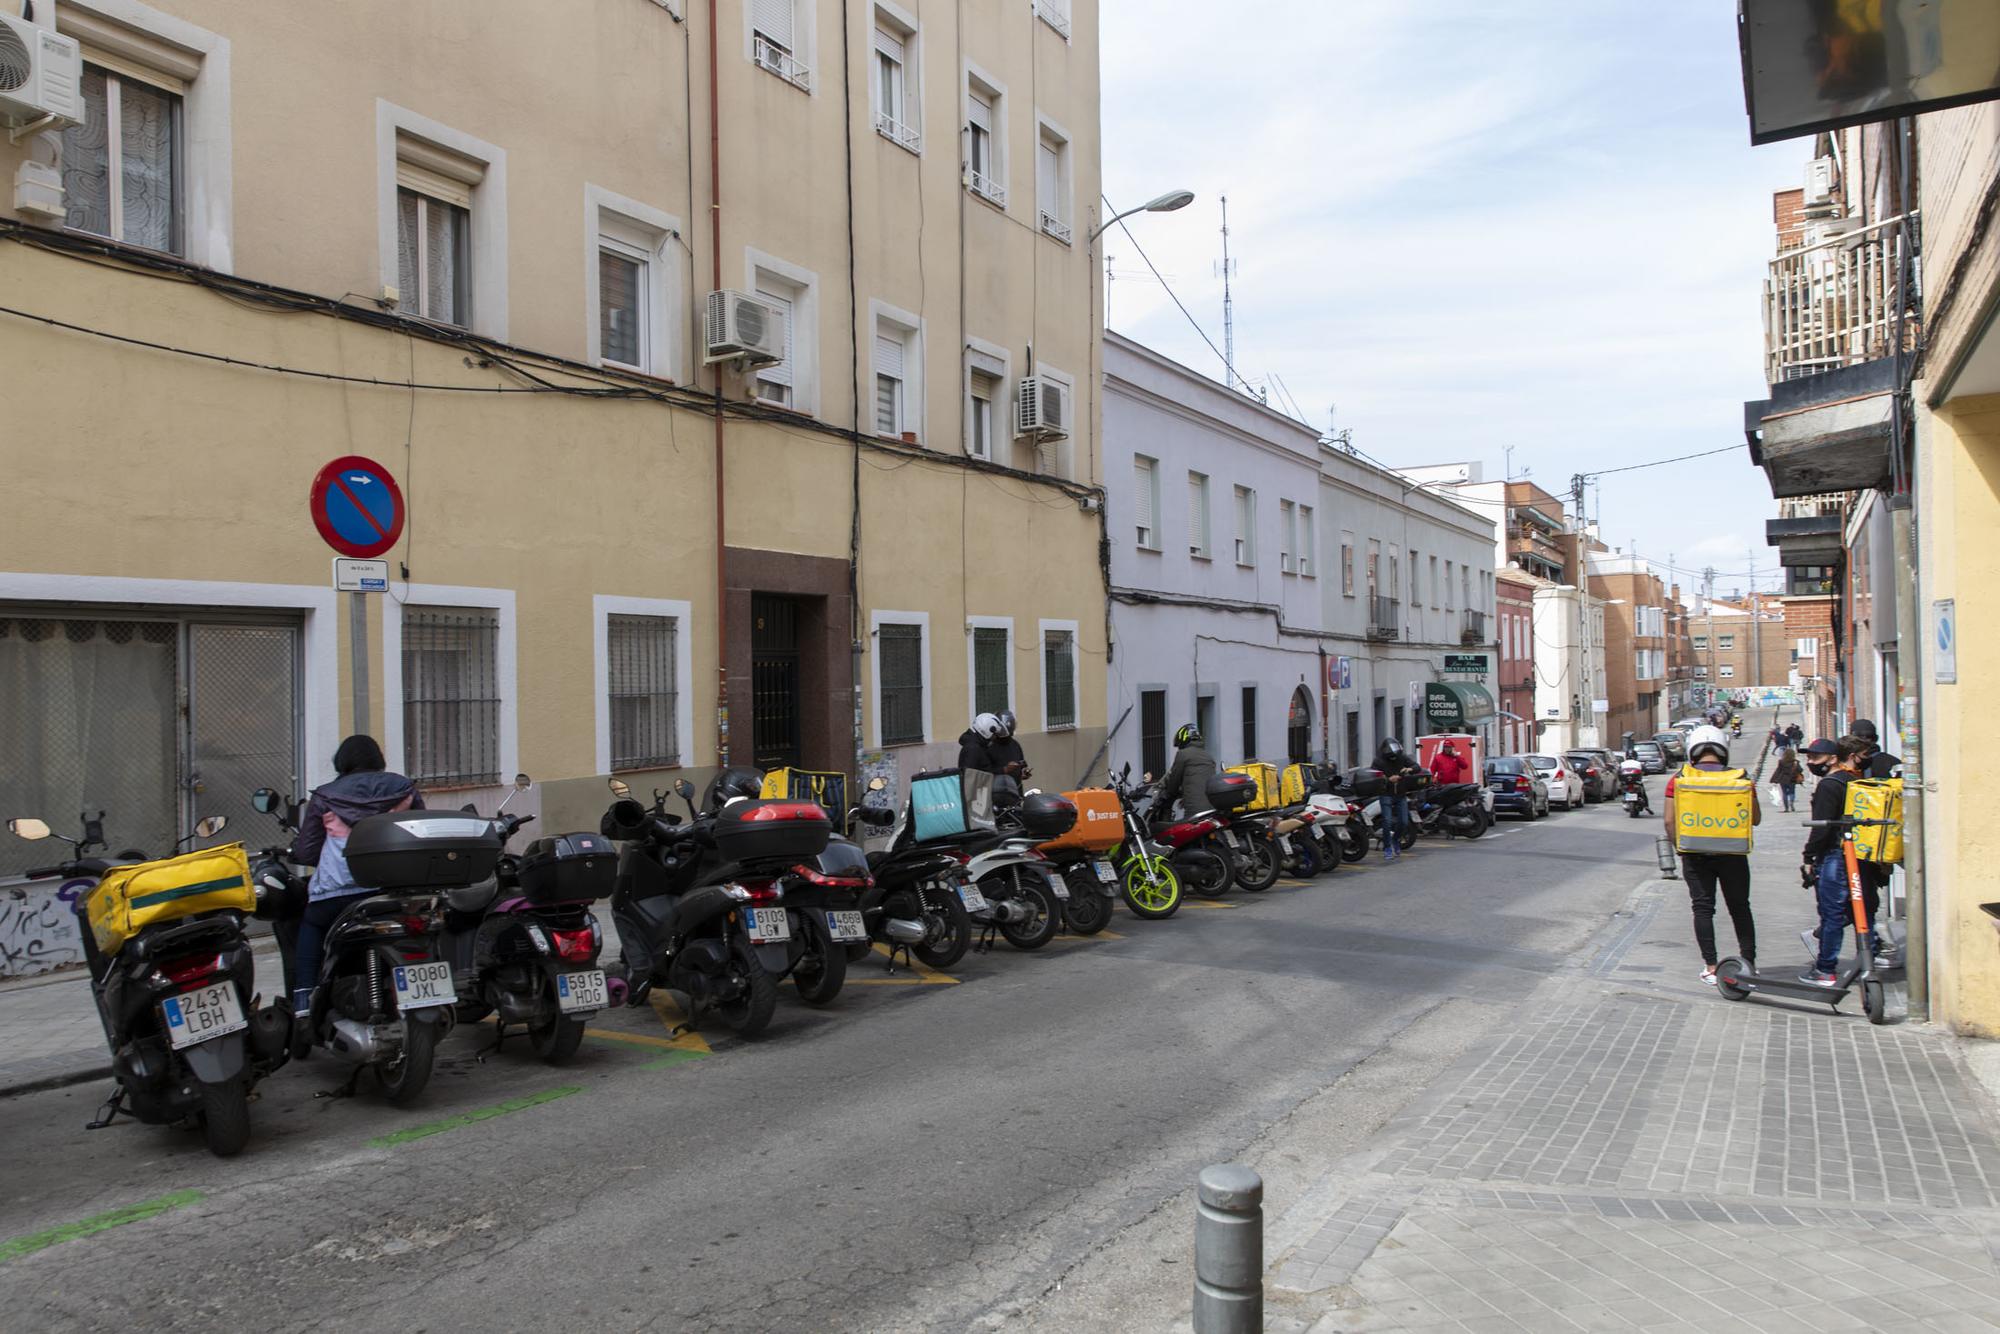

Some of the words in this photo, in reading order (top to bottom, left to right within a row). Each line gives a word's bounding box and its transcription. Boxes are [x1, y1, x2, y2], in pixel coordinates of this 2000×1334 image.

[1429, 709, 1458, 717] CASERA
[1681, 812, 1739, 829] Glovo
[756, 910, 785, 924] 6103
[836, 912, 861, 924] 4669
[408, 965, 448, 984] 3080
[569, 972, 603, 990] 5915
[182, 985, 231, 1015] 2431
[411, 982, 441, 1000] JXL
[575, 988, 601, 1006] HDG
[186, 1007, 226, 1034] LBH
